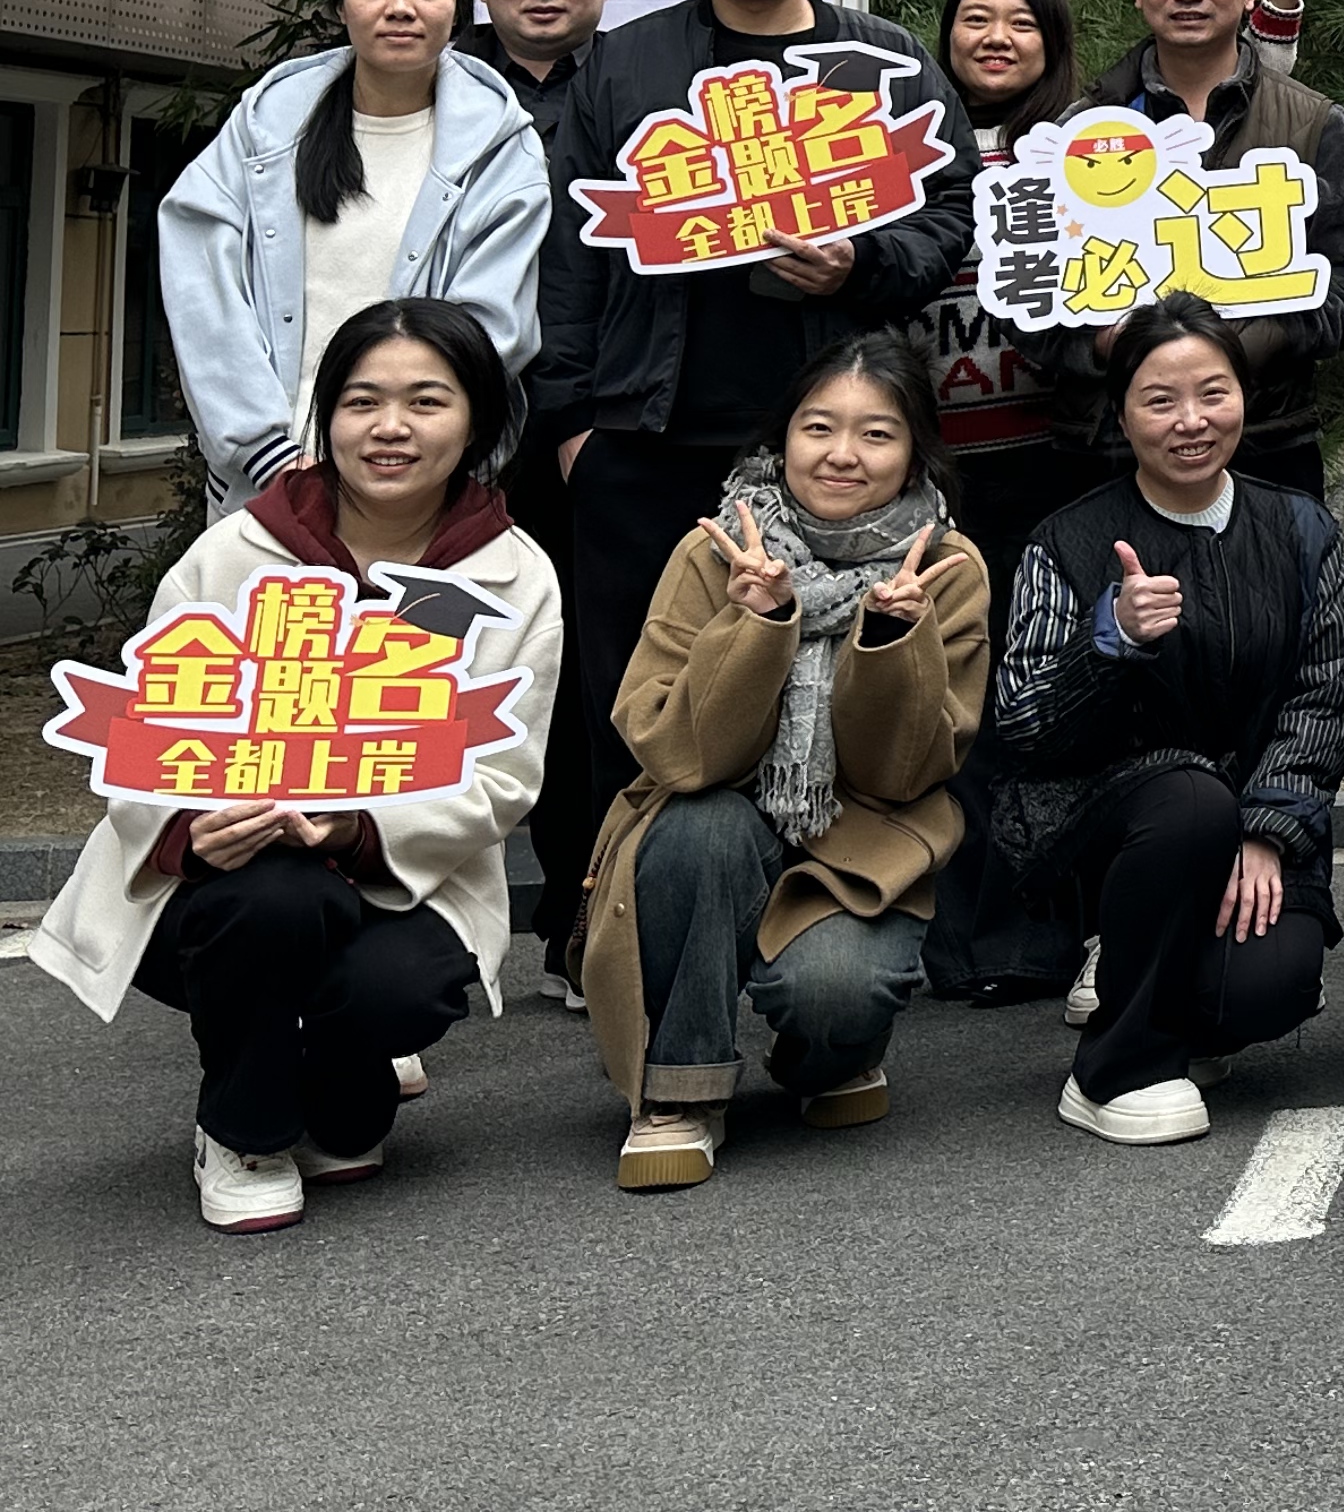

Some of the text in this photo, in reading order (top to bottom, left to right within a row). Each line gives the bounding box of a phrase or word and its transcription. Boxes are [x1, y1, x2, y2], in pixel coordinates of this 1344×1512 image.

[634, 74, 889, 207] 金榜题名
[1092, 136, 1125, 153] 必胜
[675, 177, 878, 264] 全都上岸
[134, 581, 460, 735] 金榜题名
[152, 738, 418, 795] 全都上岸
